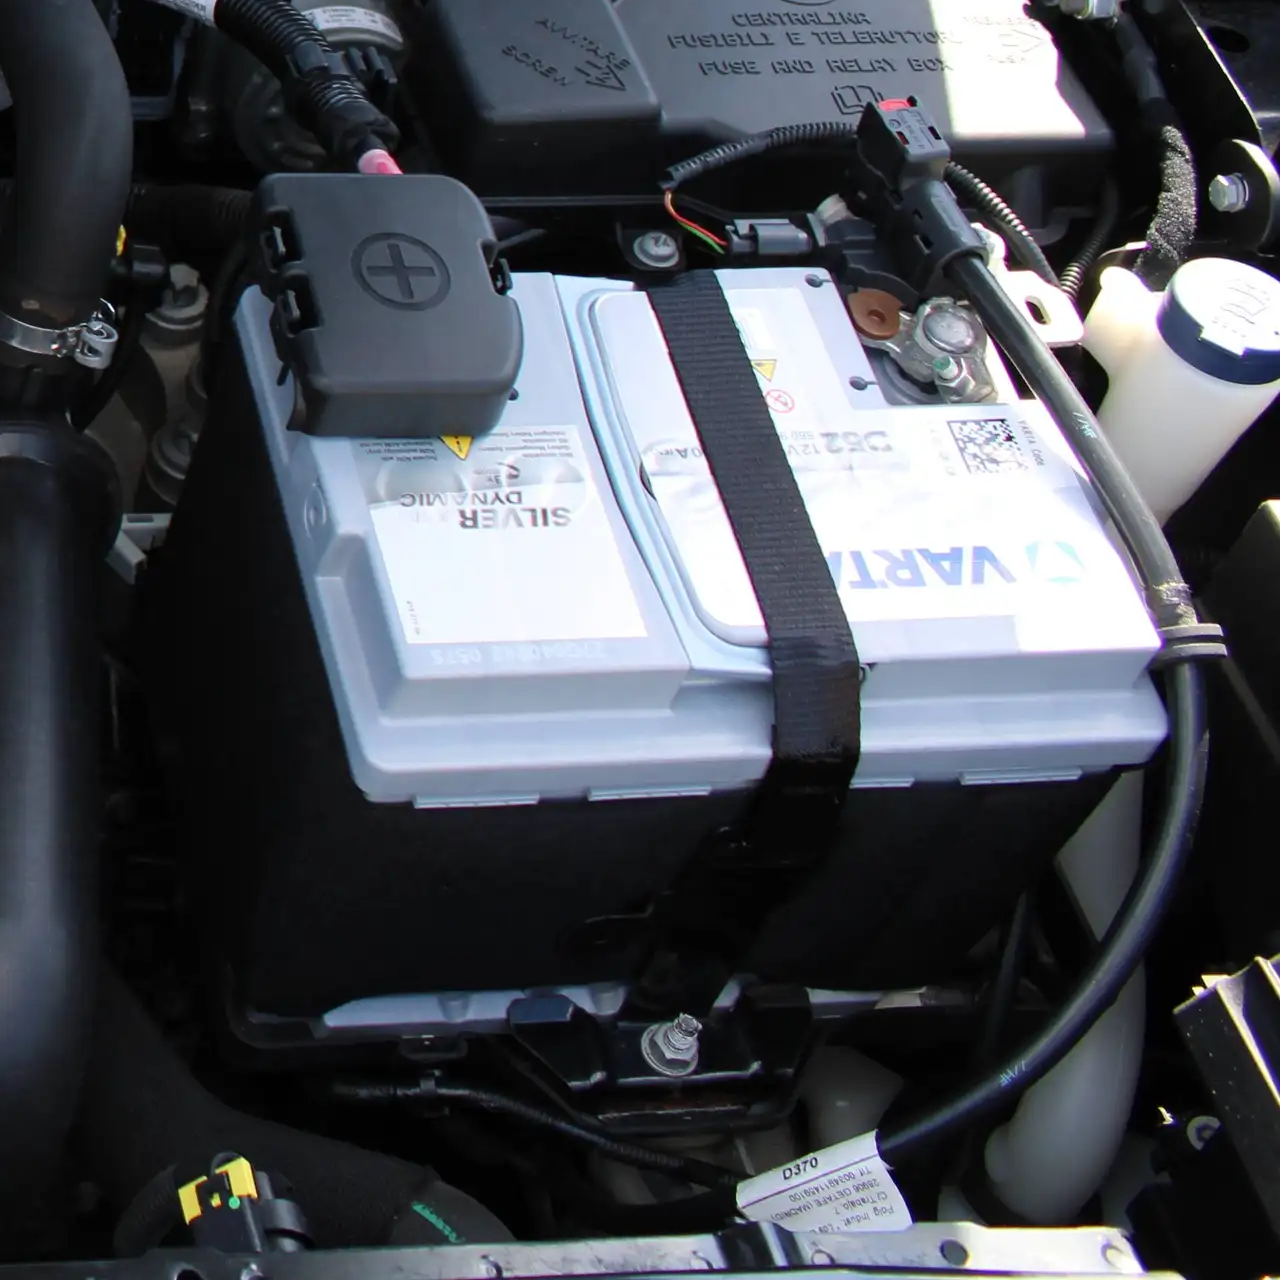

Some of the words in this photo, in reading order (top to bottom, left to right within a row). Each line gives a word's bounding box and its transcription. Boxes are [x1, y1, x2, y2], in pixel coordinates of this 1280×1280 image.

[732, 11, 872, 28] CENTRALINA
[666, 31, 777, 50] FUSIBILI
[786, 31, 806, 46] E
[698, 60, 761, 75] FUSE
[771, 58, 816, 74] AND
[826, 57, 897, 72] RELAY
[908, 56, 954, 72] BOX
[400, 491, 523, 508] DYNAMIC
[458, 507, 572, 530] SILVER
[782, 1156, 819, 1181] D370
[816, 1186, 858, 1208] GETAFE
[771, 1200, 815, 1221] (MADRID)
